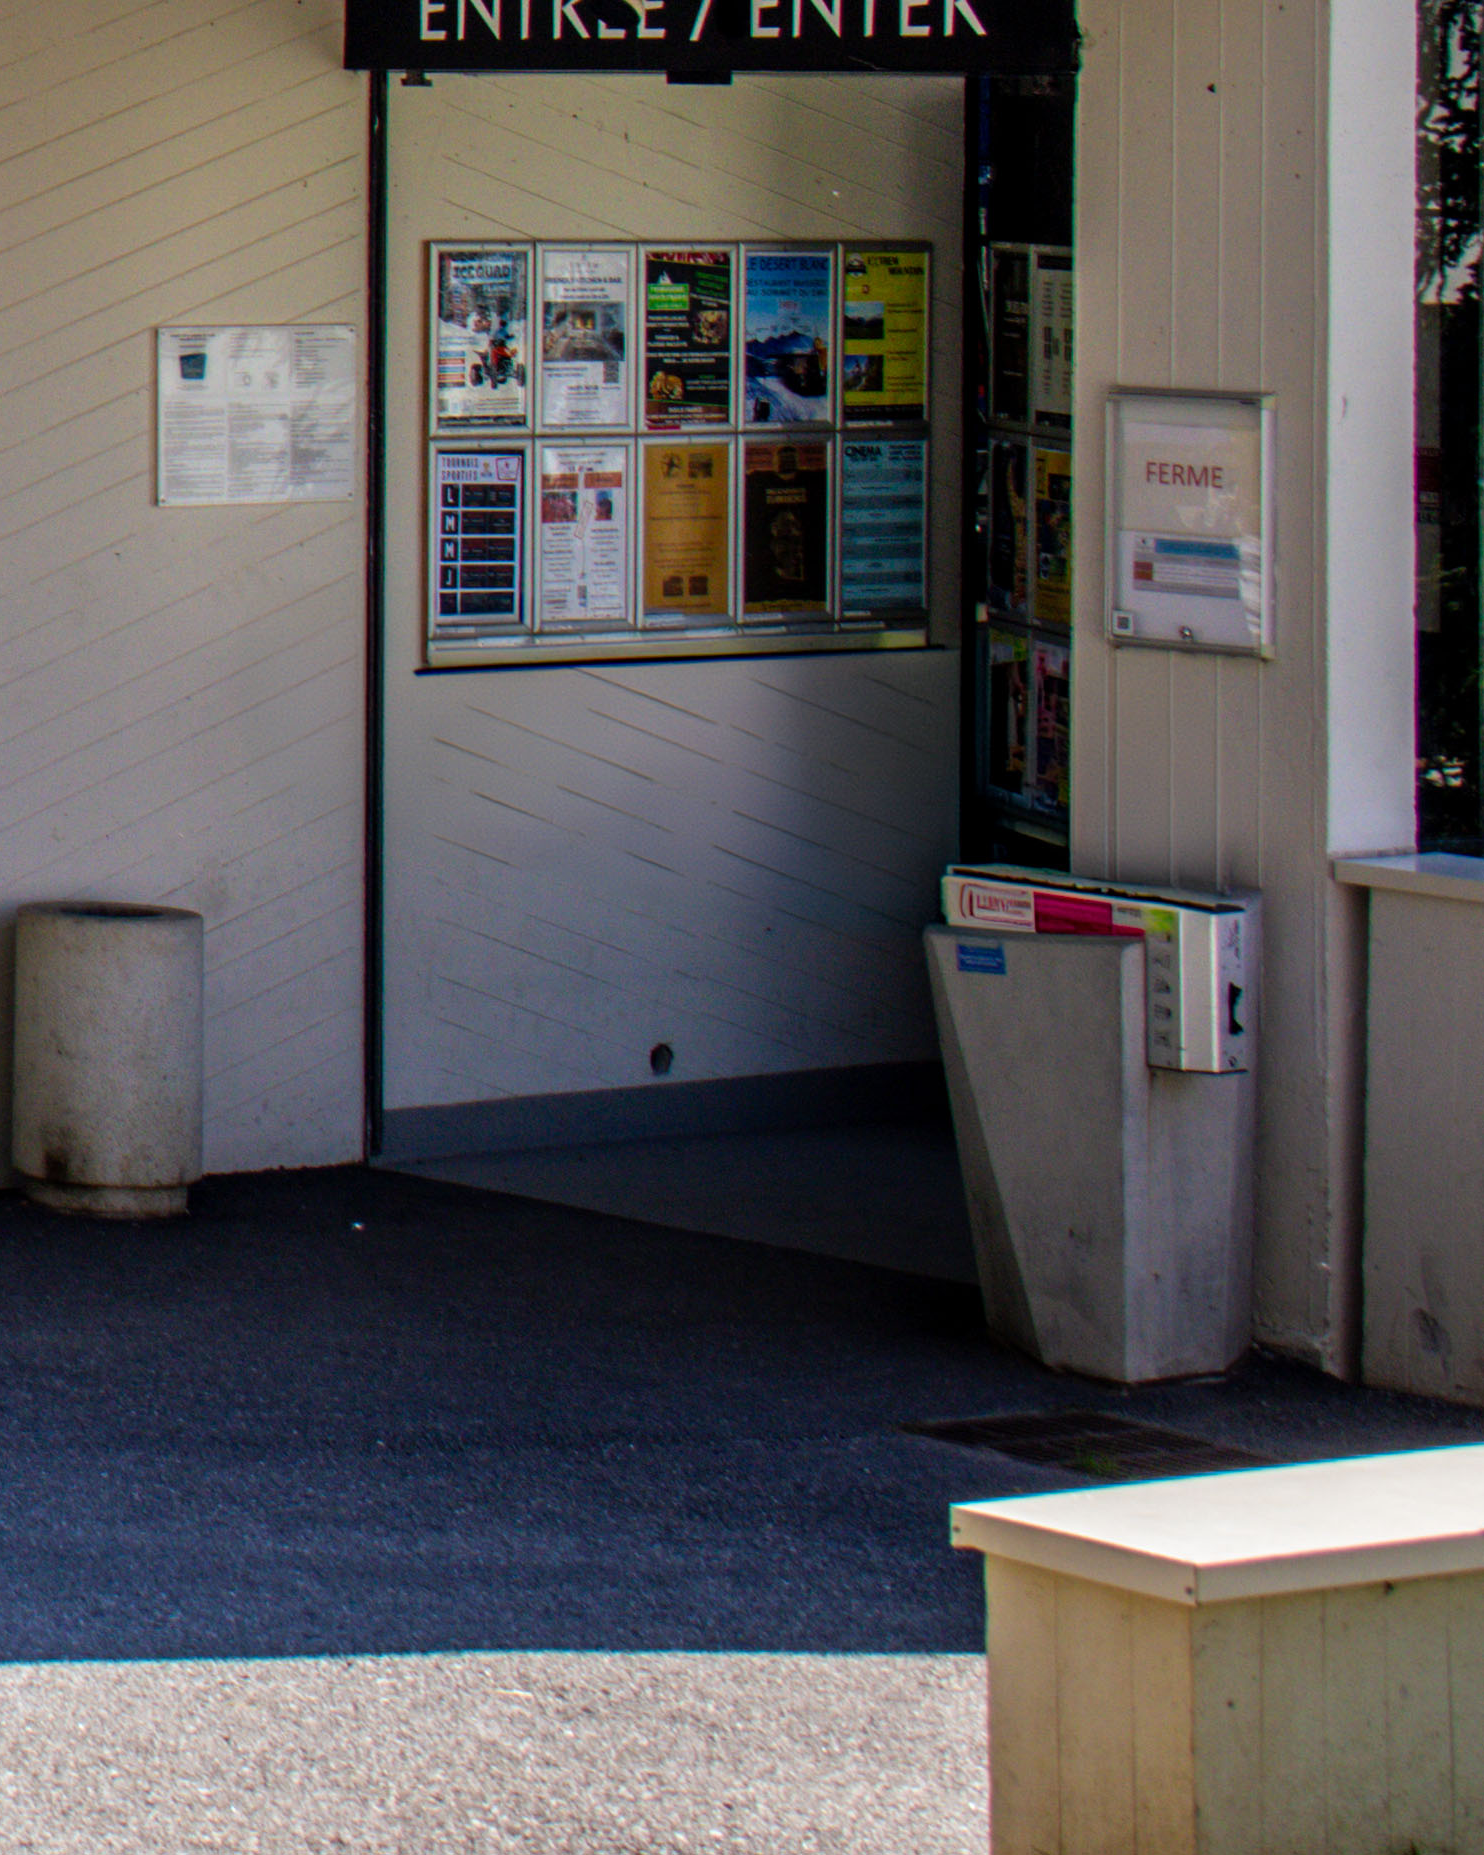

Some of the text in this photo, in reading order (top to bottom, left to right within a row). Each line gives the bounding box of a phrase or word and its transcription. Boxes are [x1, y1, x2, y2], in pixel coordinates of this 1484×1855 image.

[442, 457, 478, 468] TOURNOIS
[442, 470, 478, 481] SPORTIFS
[1146, 461, 1223, 488] FERME
